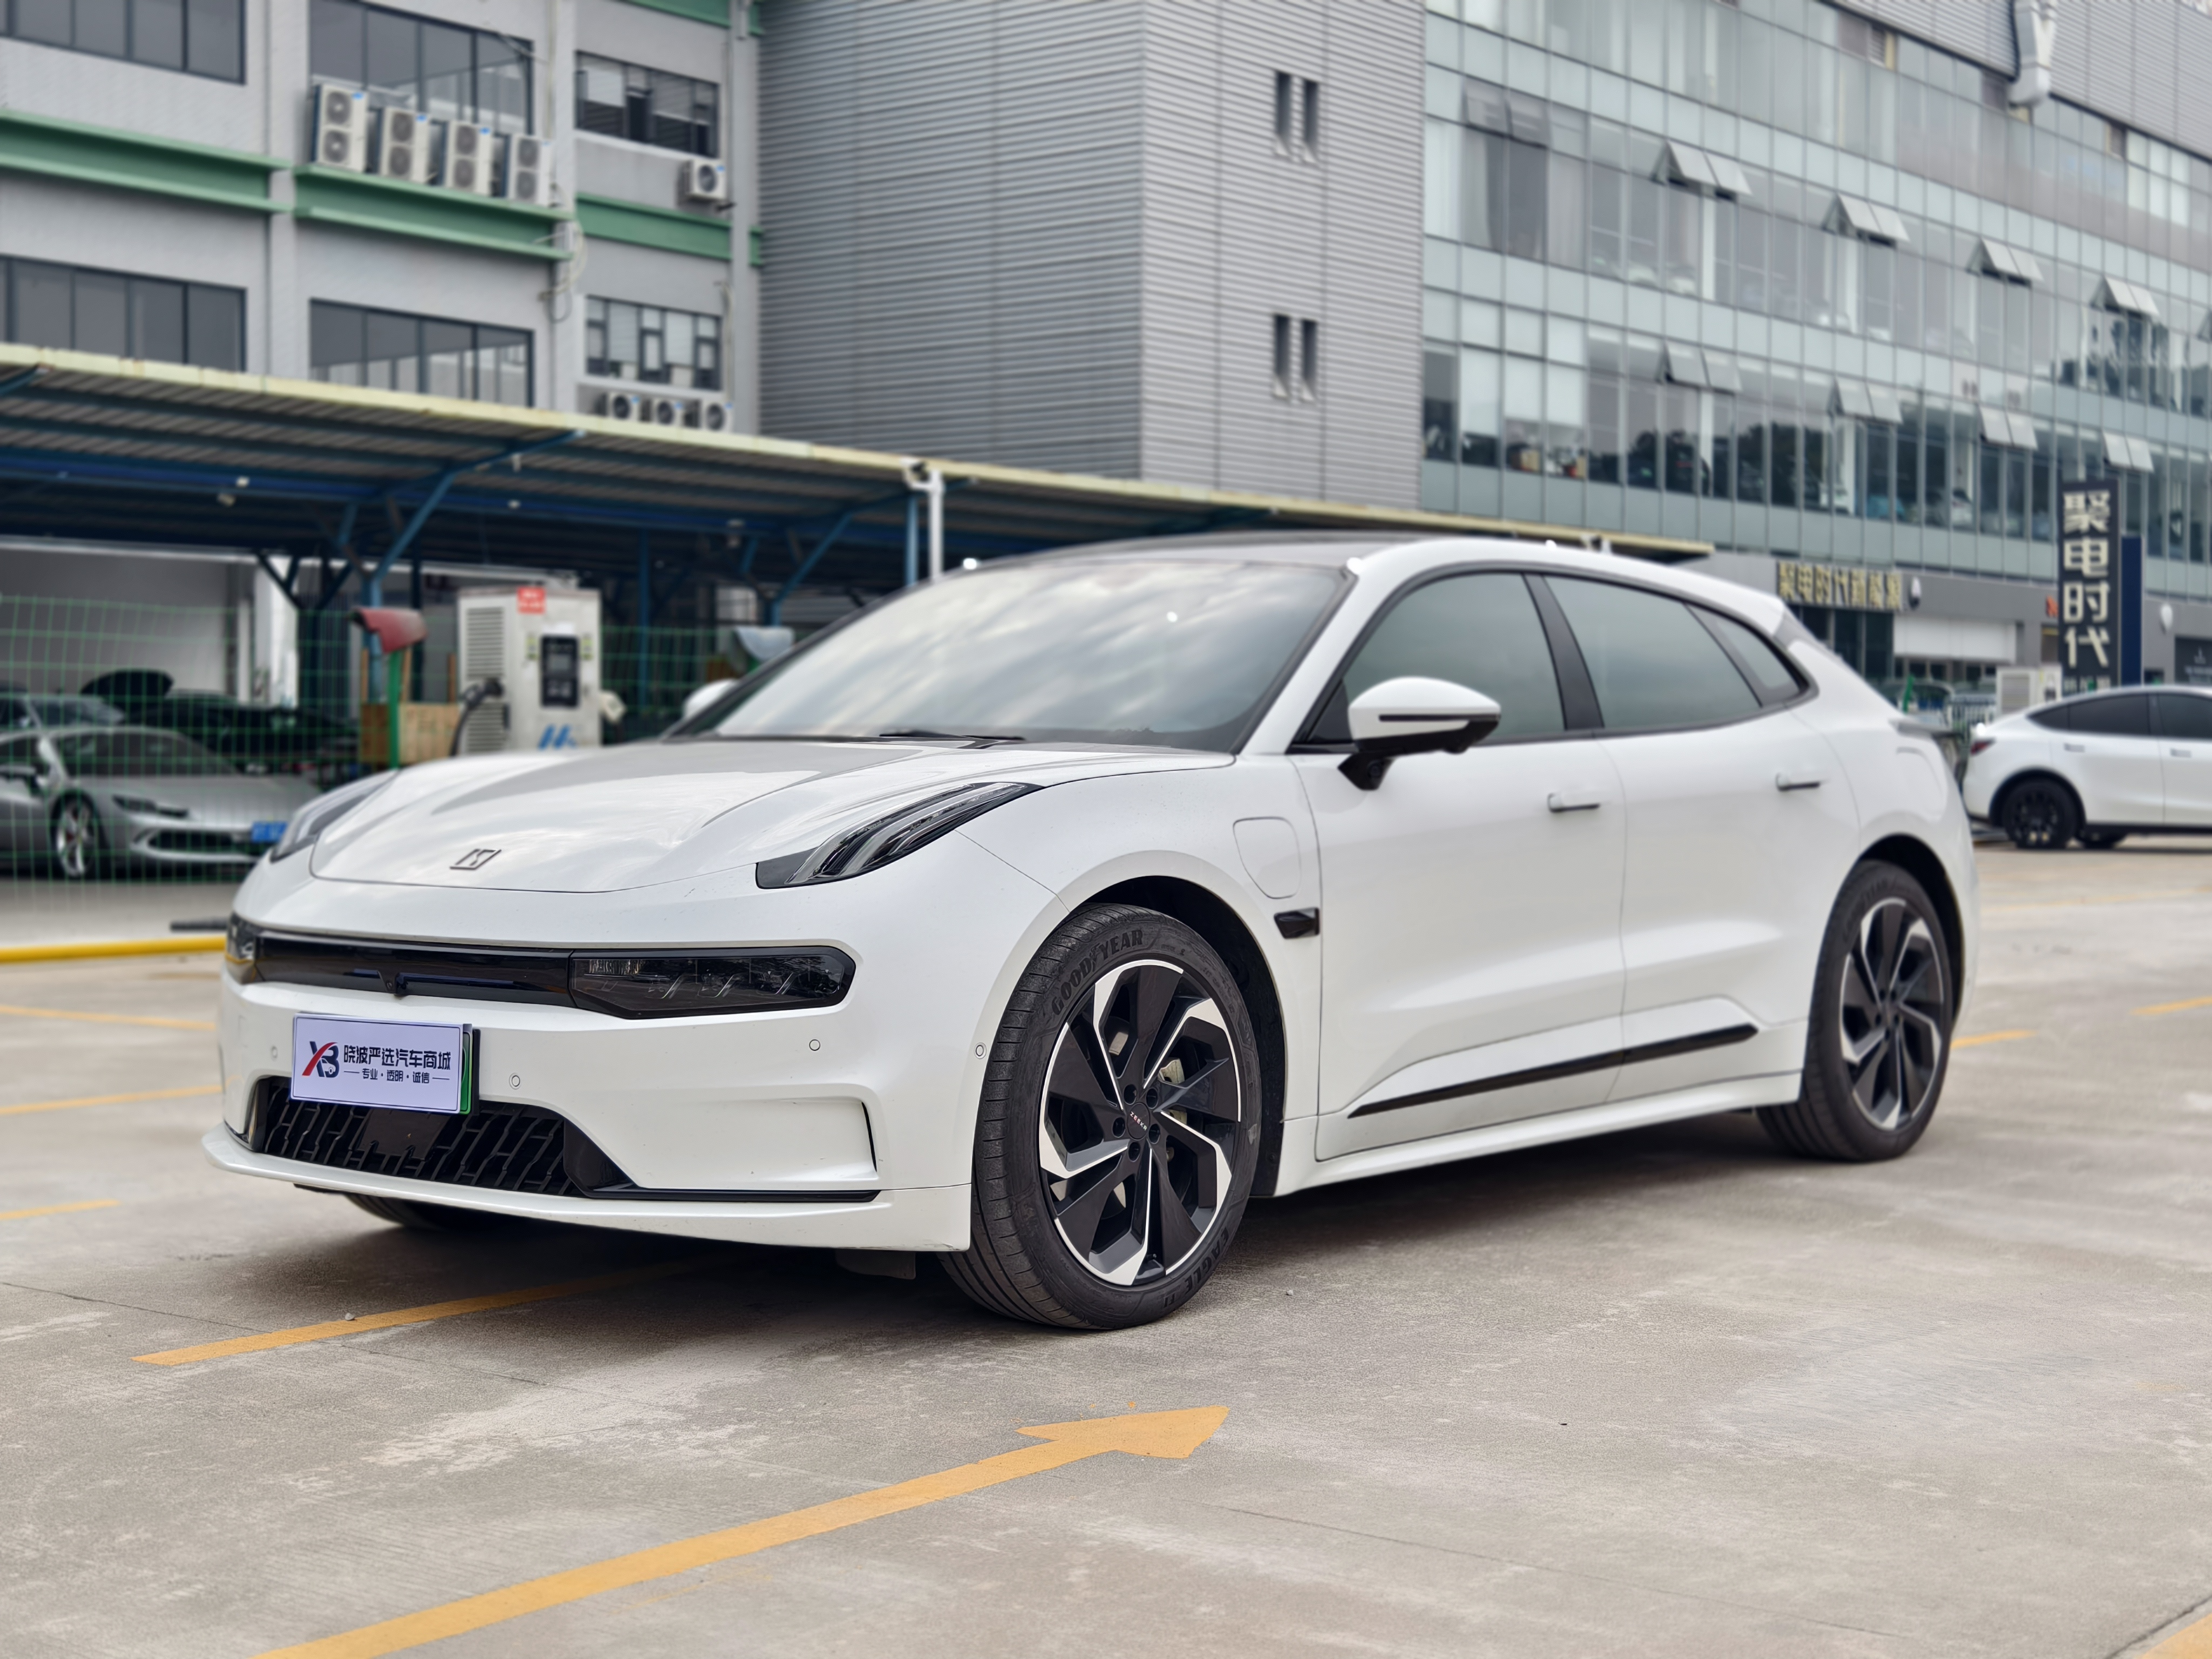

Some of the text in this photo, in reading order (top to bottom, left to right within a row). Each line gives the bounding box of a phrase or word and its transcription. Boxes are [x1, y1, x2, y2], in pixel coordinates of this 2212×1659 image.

[2063, 491, 2110, 668] 聚电时代
[1051, 929, 1143, 1015] GOODYEAR
[343, 1044, 451, 1070] 晓波严选汽车商城
[1130, 1111, 1147, 1131] ZEEKR
[1184, 1226, 1229, 1295] EAGLE
